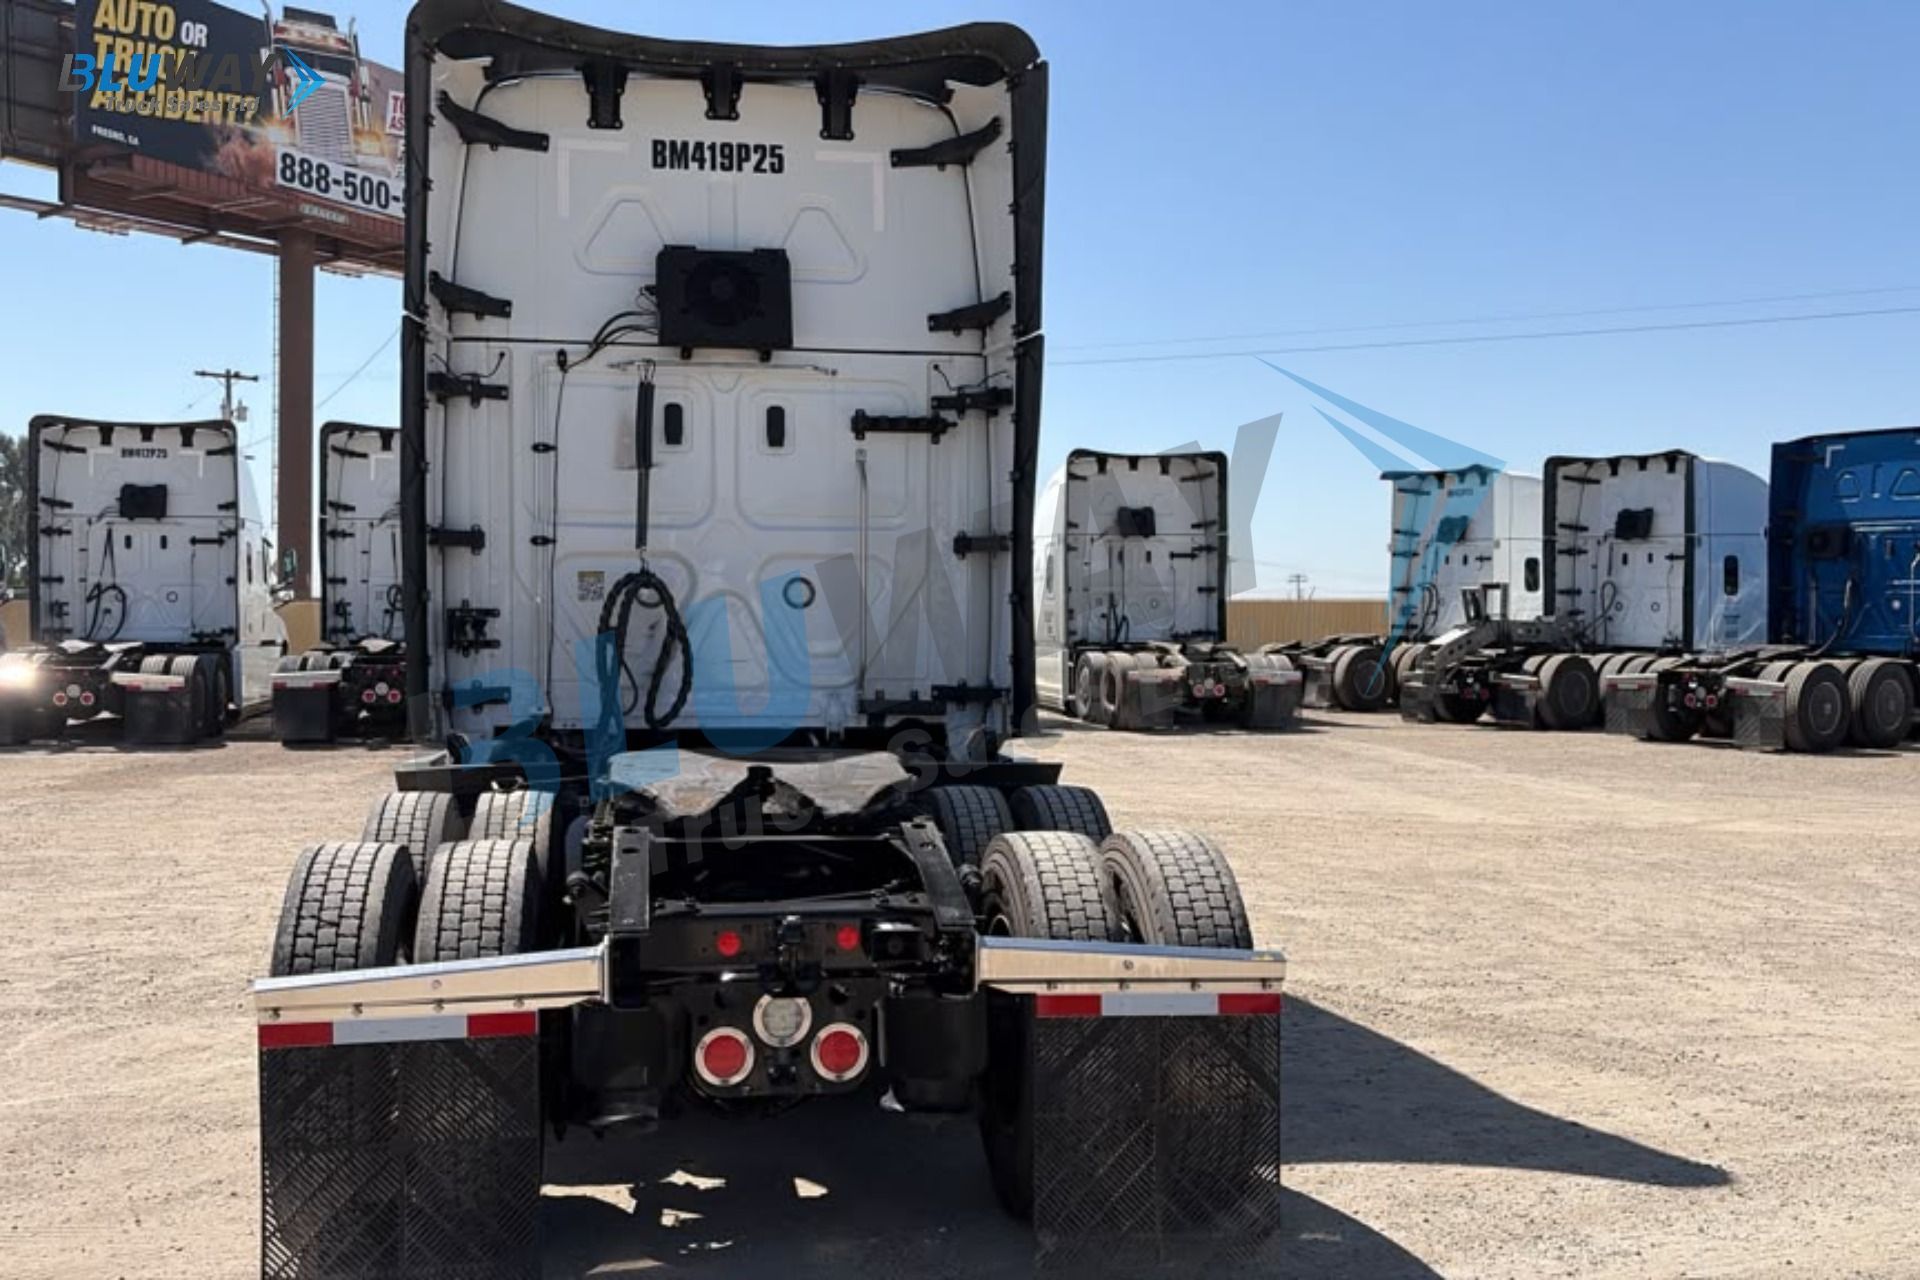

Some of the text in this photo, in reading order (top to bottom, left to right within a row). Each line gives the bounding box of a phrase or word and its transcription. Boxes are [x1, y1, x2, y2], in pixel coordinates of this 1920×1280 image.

[93, 0, 209, 48] AUTO OR
[652, 139, 784, 174] BM419P25
[280, 152, 405, 210] 888-500-
